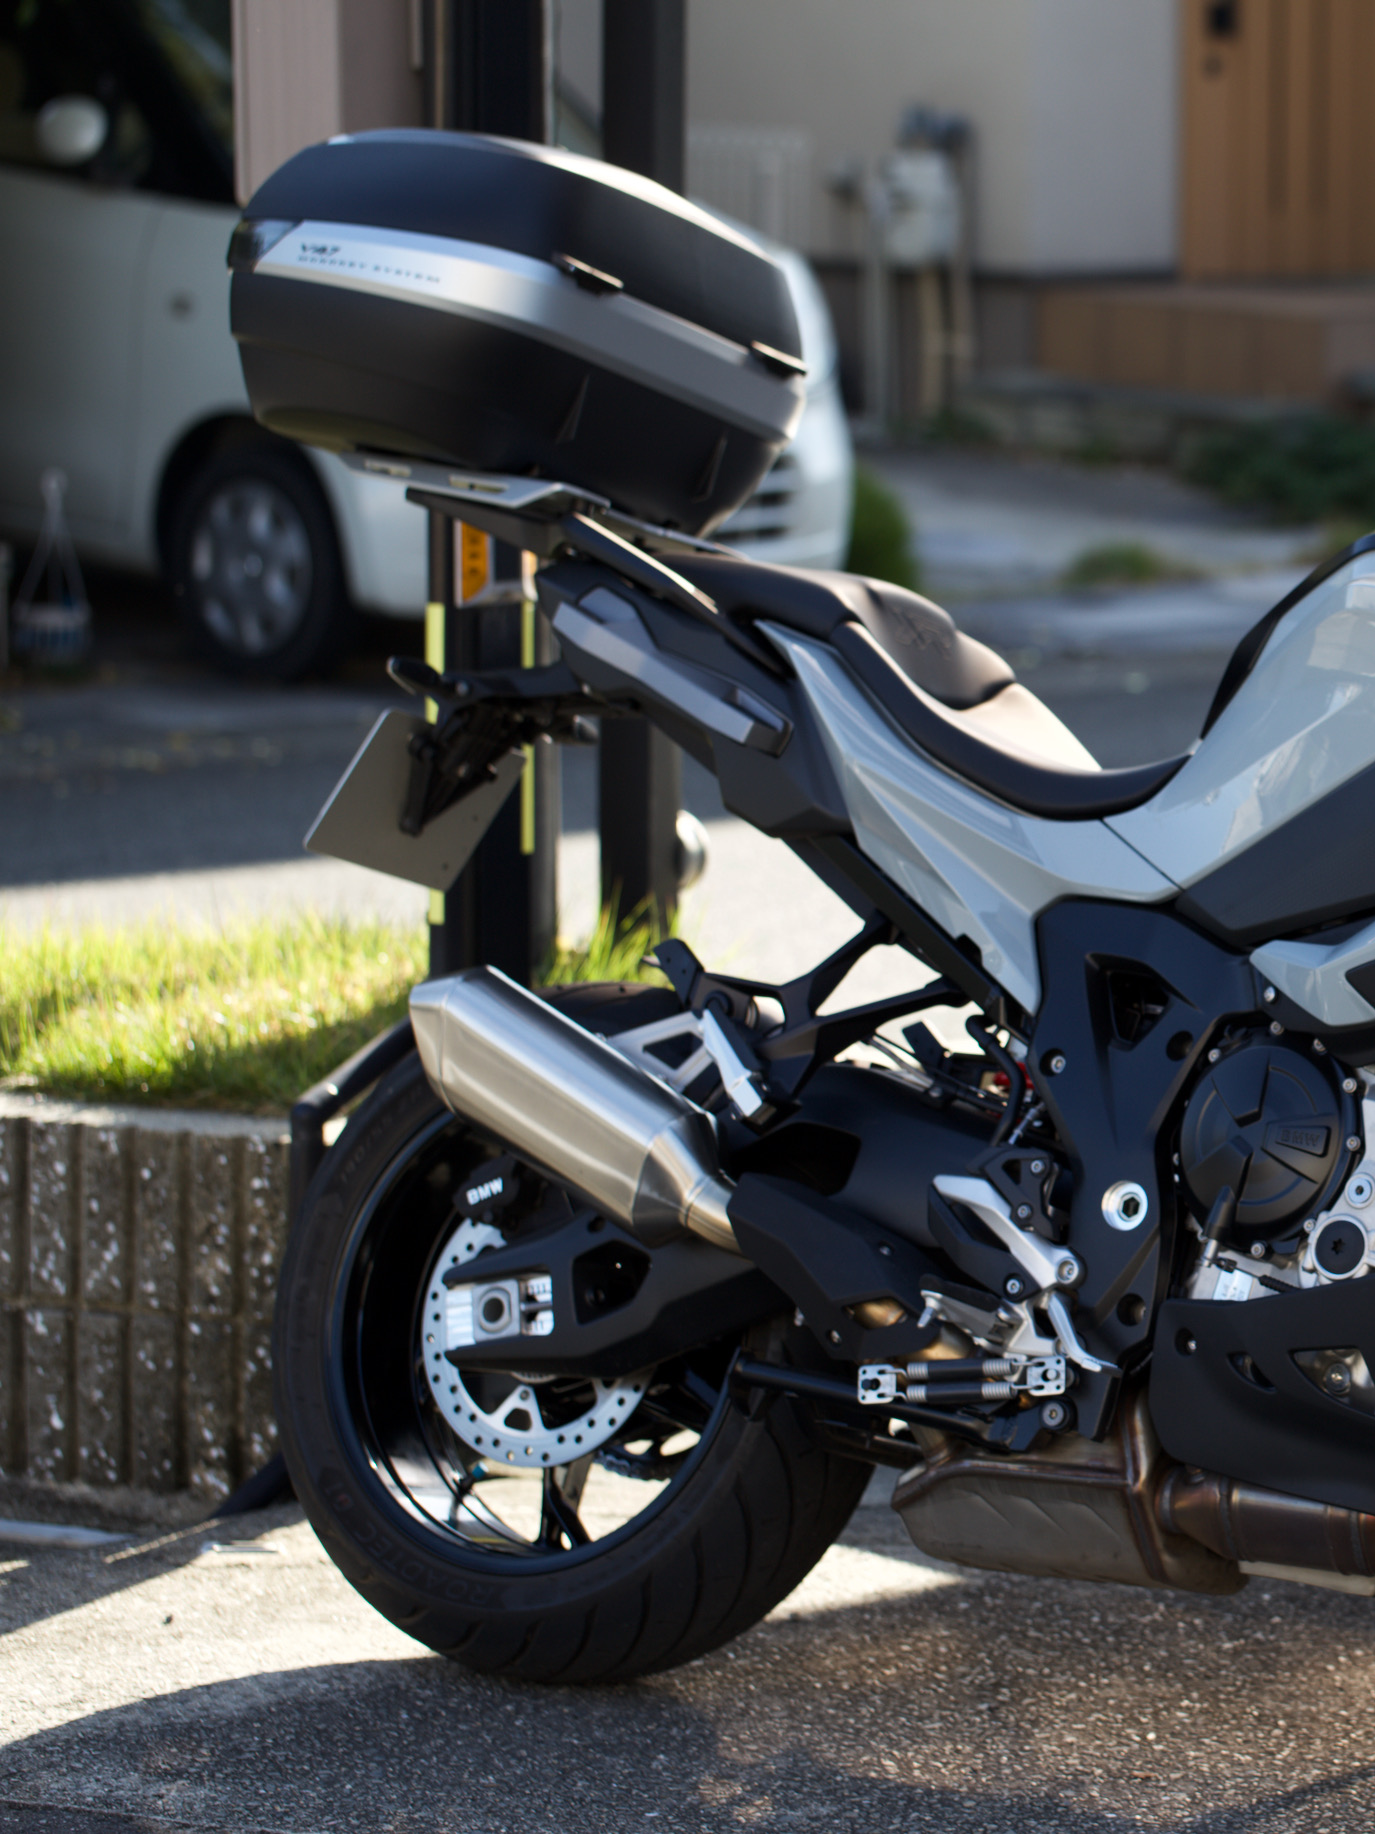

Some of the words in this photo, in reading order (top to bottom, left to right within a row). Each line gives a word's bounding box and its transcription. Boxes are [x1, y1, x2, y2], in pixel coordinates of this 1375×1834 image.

[1280, 1128, 1321, 1148] BMW
[466, 1176, 504, 1206] BMW
[355, 1520, 496, 1602] ROADTEC
